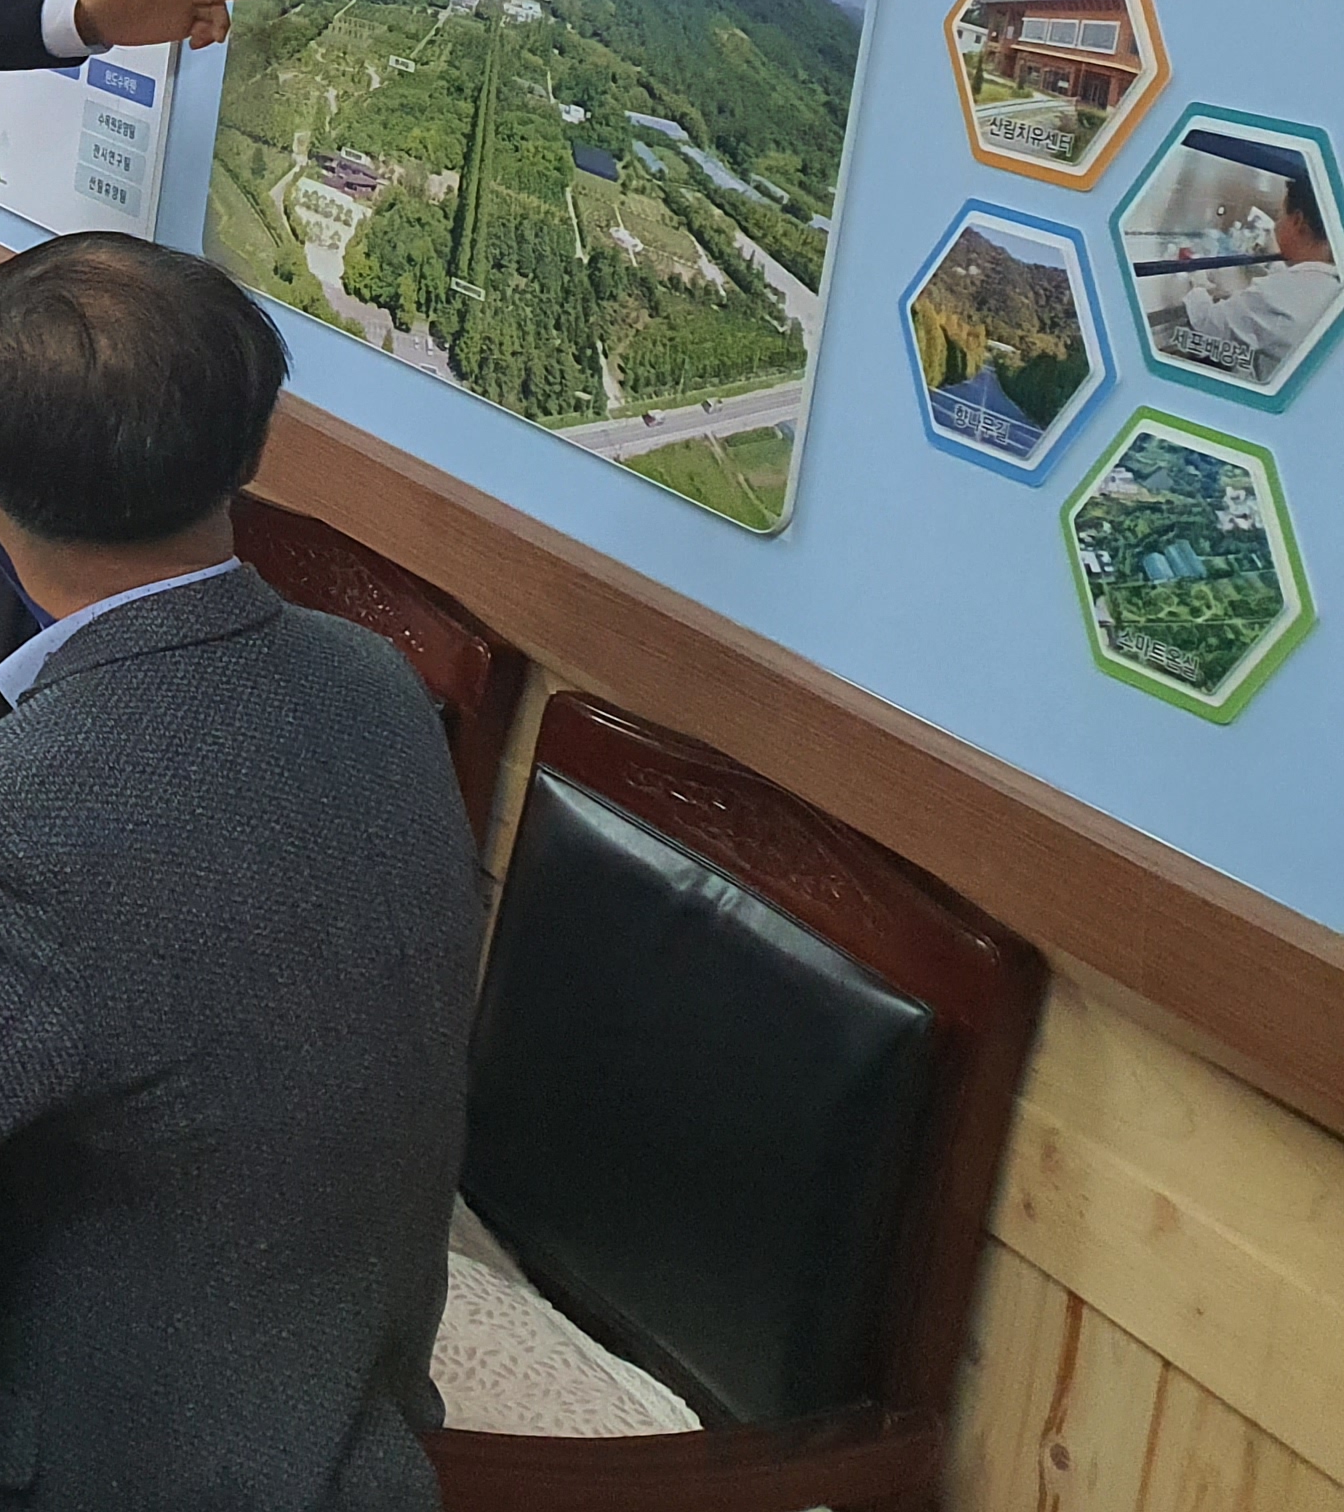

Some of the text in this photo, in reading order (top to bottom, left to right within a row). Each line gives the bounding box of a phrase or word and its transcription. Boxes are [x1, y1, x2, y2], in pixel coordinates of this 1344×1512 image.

[989, 117, 1074, 157] 산림치유센터
[1172, 326, 1255, 370] 세포배양실
[955, 404, 1010, 445] 향나무길
[1116, 628, 1199, 682] 스마트온실
